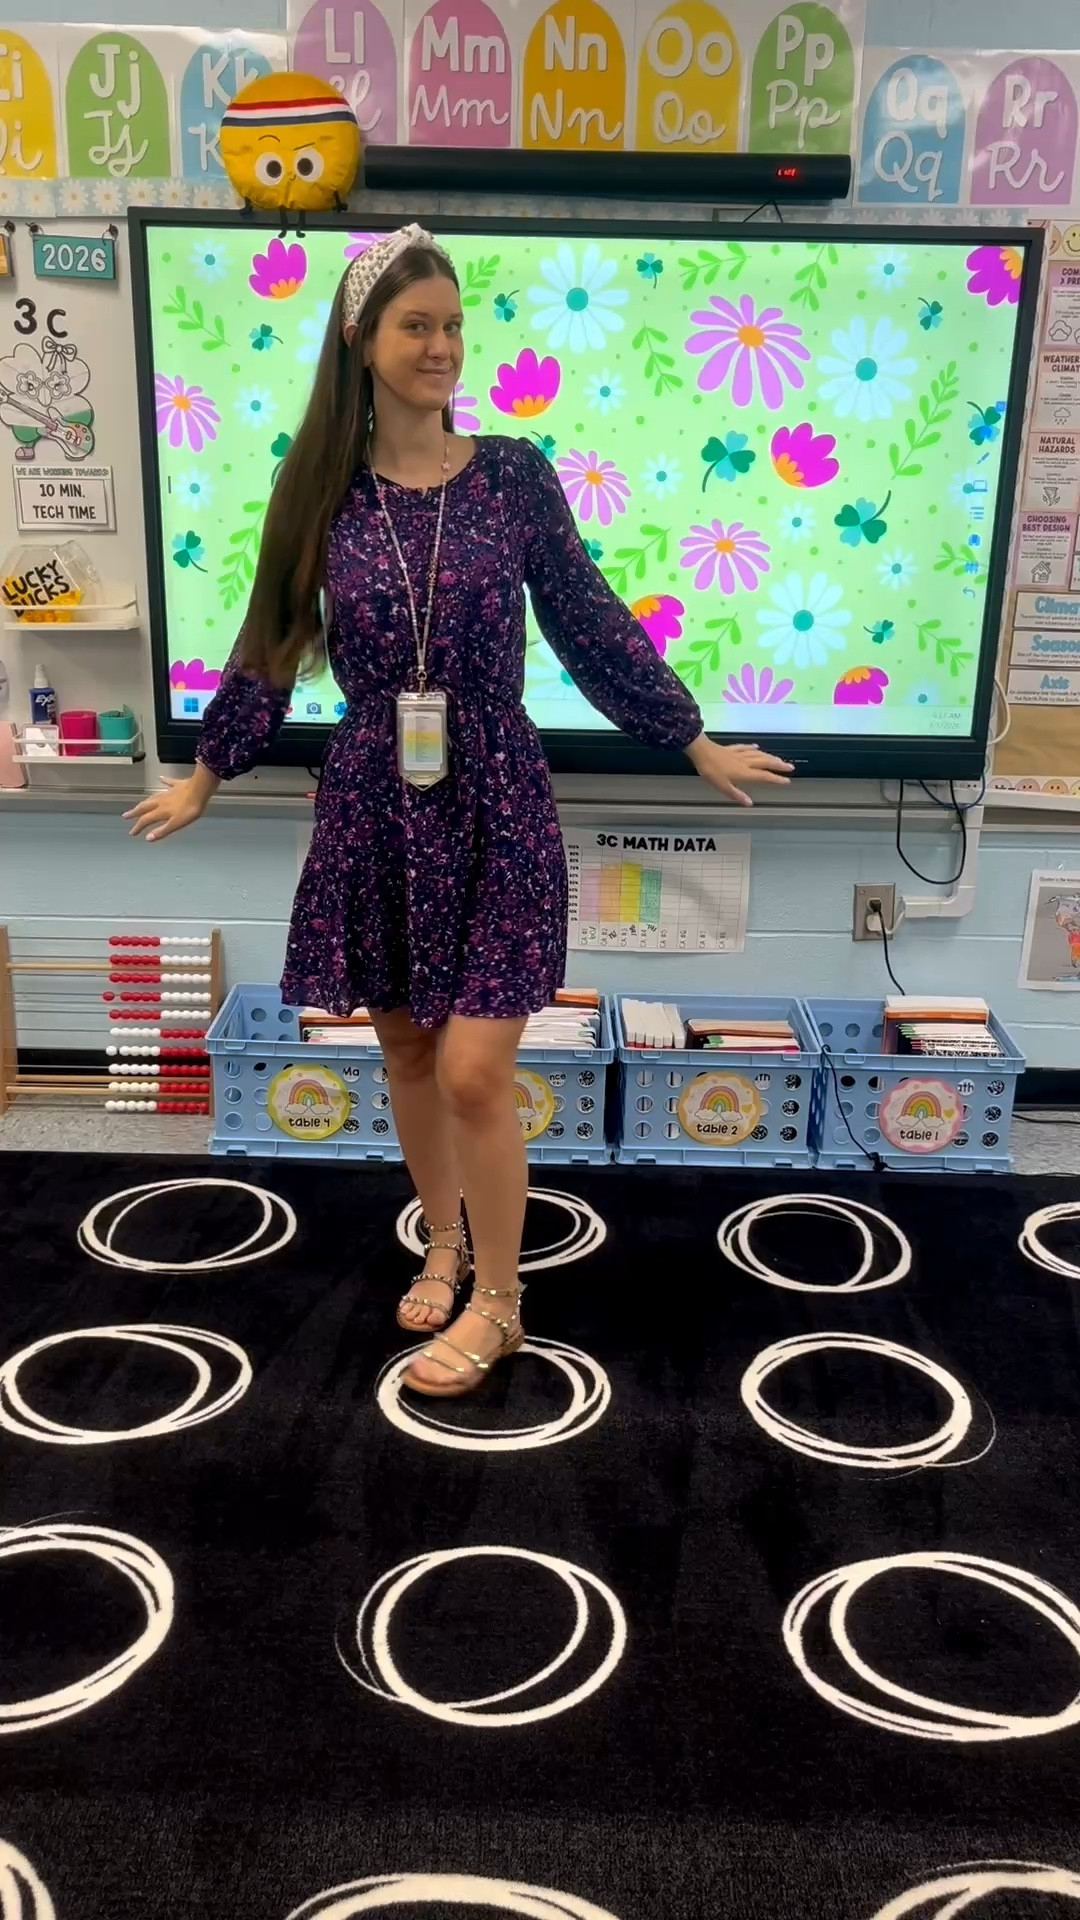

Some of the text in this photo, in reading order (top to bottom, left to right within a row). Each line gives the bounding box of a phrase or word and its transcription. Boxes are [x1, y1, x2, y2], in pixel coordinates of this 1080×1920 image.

[421, 15, 506, 73] Mm
[544, 14, 608, 71] Nn
[647, 16, 733, 78] Oo
[775, 15, 835, 86] Pp
[89, 43, 142, 119] Jj
[1002, 74, 1059, 129] Rr
[410, 84, 510, 128] Mm
[530, 88, 624, 144] Nn
[653, 90, 727, 144] Oo
[766, 79, 841, 149] Pp
[886, 68, 950, 138] Qq
[873, 130, 946, 202] Qq
[986, 140, 1066, 193] Rr
[41, 243, 107, 272] 2026
[14, 297, 68, 338] 3 C
[1038, 445, 1076, 454] HAZARDS
[1040, 436, 1075, 444] NATURAL
[15, 467, 27, 476] WE
[39, 483, 85, 498] 10 MIN.
[32, 505, 96, 519] TECH TIME
[1022, 523, 1071, 532] BEST DESIGN
[1026, 515, 1067, 523] CHOOSING
[1, 559, 60, 601] LUCKY
[1040, 674, 1070, 690] Axis
[596, 834, 717, 852] 3C MATH DATA
[288, 1117, 331, 1128] table 4
[525, 1121, 532, 1131] 3
[696, 1123, 738, 1135] table 2
[900, 1129, 939, 1141] table 1
